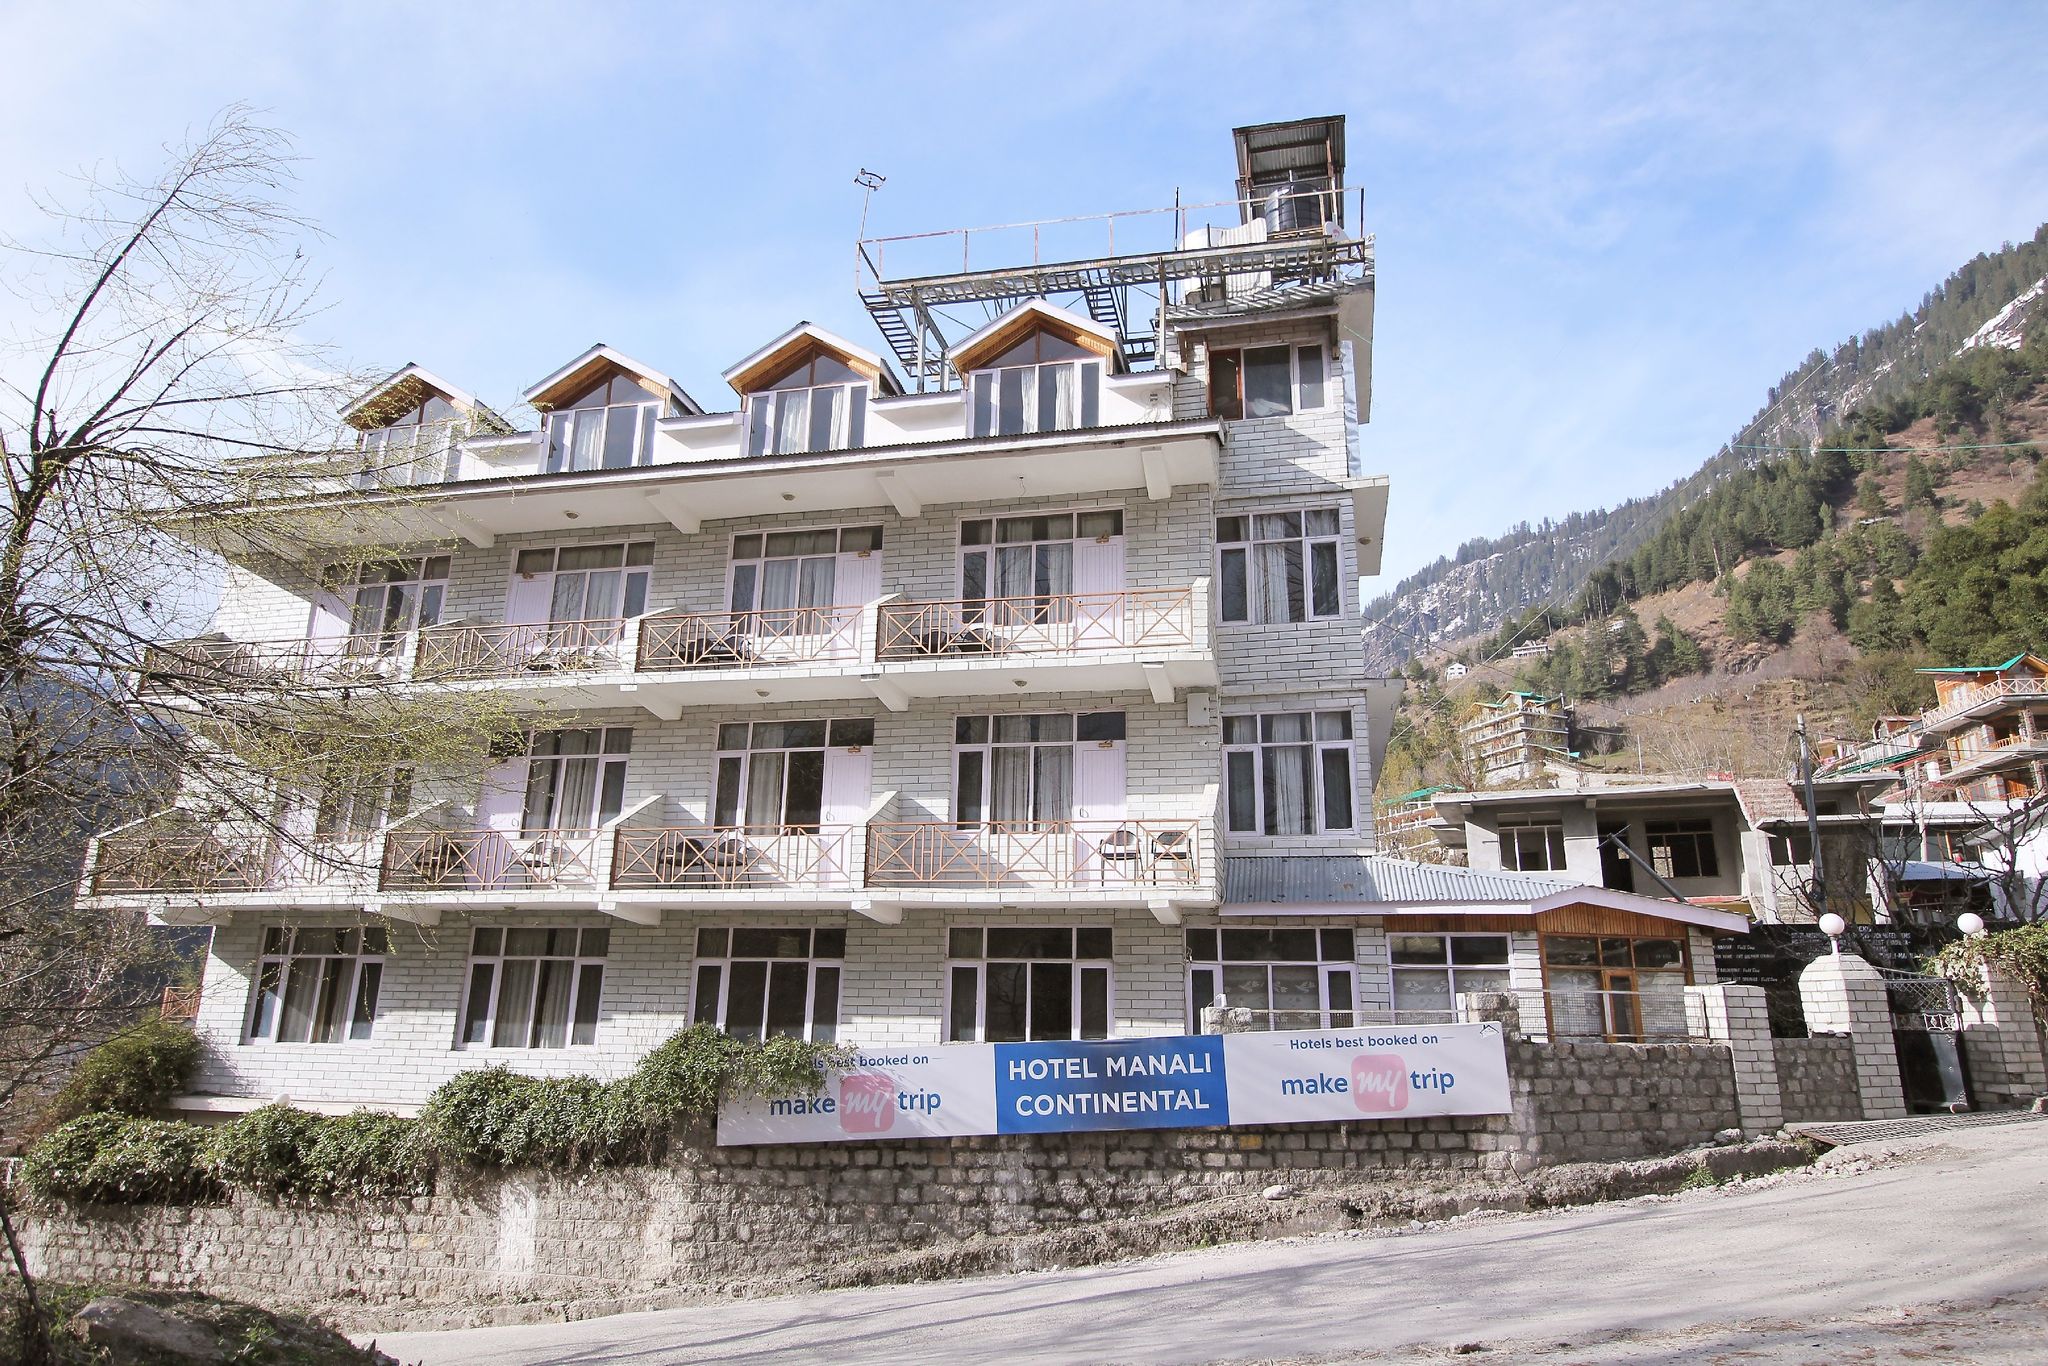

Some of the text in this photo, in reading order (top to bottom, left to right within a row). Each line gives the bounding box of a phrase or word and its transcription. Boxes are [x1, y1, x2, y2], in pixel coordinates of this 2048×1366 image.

[1290, 1033, 1438, 1050] Hotels best booked on
[859, 1054, 908, 1067] booked
[912, 1055, 929, 1065] on
[1009, 1052, 1212, 1081] HOTEL MANALI
[1281, 1067, 1455, 1108] make my trip
[769, 1087, 941, 1128] make my trip
[1015, 1088, 1210, 1117] CONTINENTAL
